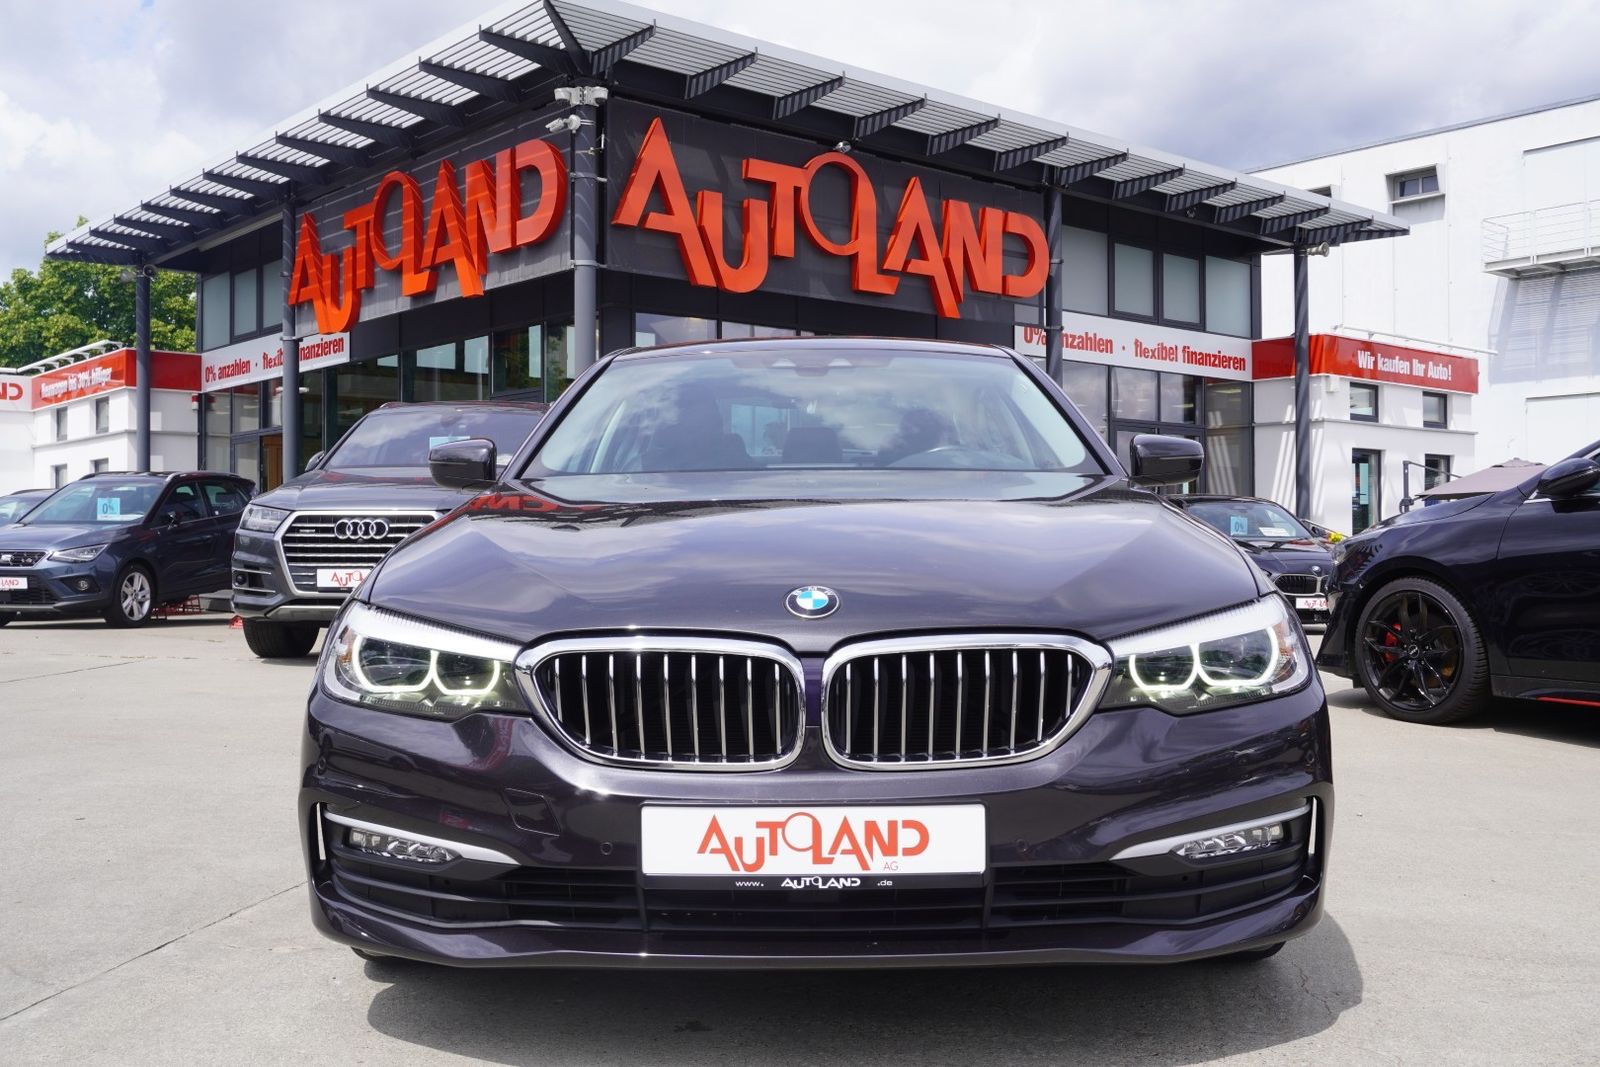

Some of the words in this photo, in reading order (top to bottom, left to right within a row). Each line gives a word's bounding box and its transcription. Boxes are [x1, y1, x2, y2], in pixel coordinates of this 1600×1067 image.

[288, 139, 568, 334] AUTOLAND
[611, 116, 1050, 318] AUTOLAND
[205, 365, 216, 383] 0%
[218, 358, 250, 379] anzahlen
[300, 337, 344, 361] nanzieren
[1062, 332, 1113, 354] nzahlen
[1134, 338, 1178, 362] flexibel
[1182, 345, 1246, 371] finanzieren
[1358, 350, 1375, 370] Wir
[1377, 353, 1410, 375] kaufen
[1412, 358, 1425, 377] Ihr
[1428, 361, 1452, 381] Auto!
[697, 812, 930, 872] AUTOLAND
[883, 862, 899, 871] AG
